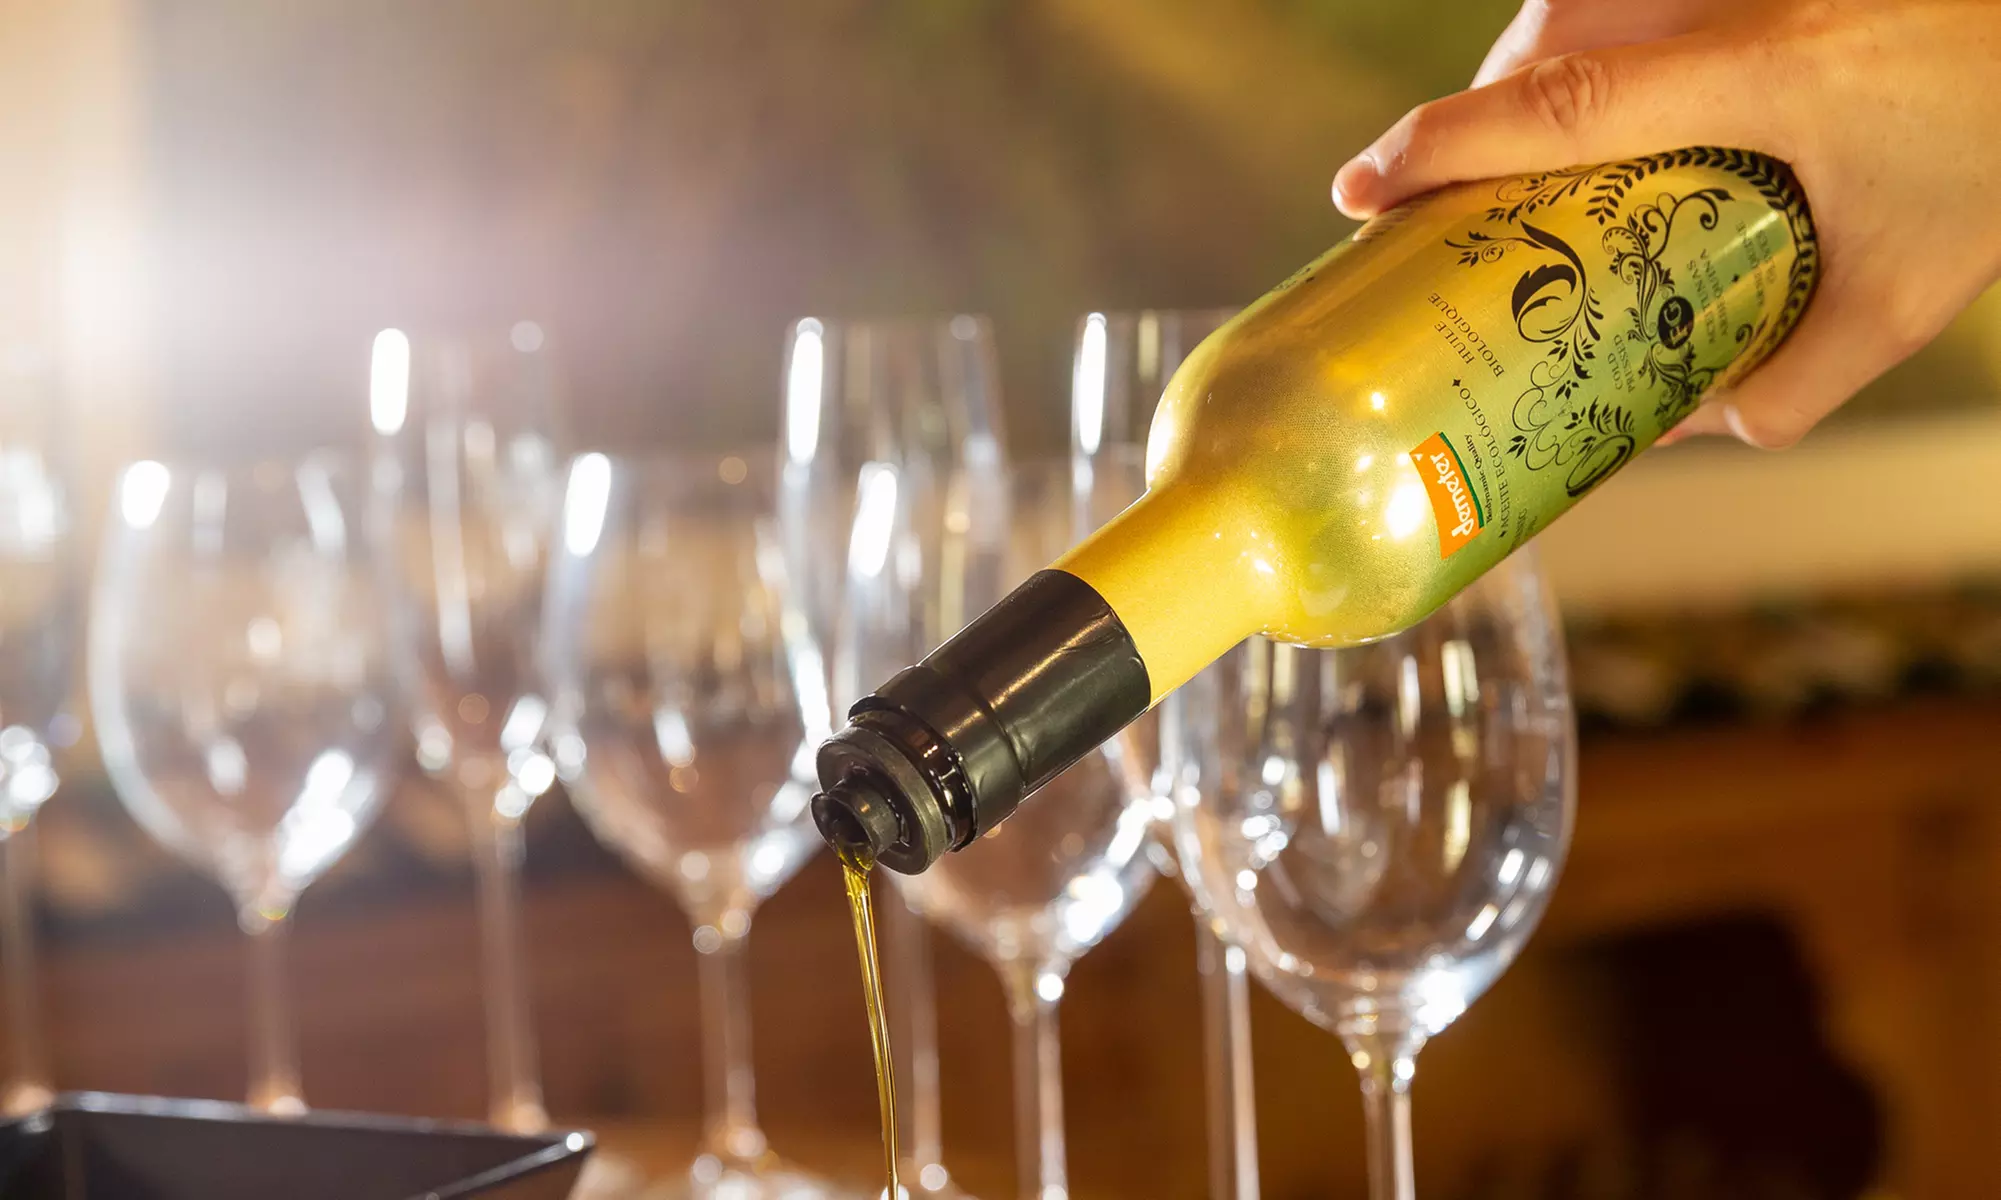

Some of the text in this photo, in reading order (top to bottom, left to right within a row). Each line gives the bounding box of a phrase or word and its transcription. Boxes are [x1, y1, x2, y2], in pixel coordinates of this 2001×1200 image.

[1427, 292, 1505, 378] BIOLOGIQUE
[1433, 320, 1476, 365] HUILE
[1613, 334, 1636, 393] PRESSED
[1607, 353, 1624, 391] COLD
[1459, 387, 1511, 528] ACEITE ECOLÓGICO
[1463, 433, 1483, 470] Quality
[1429, 451, 1475, 538] demeter
